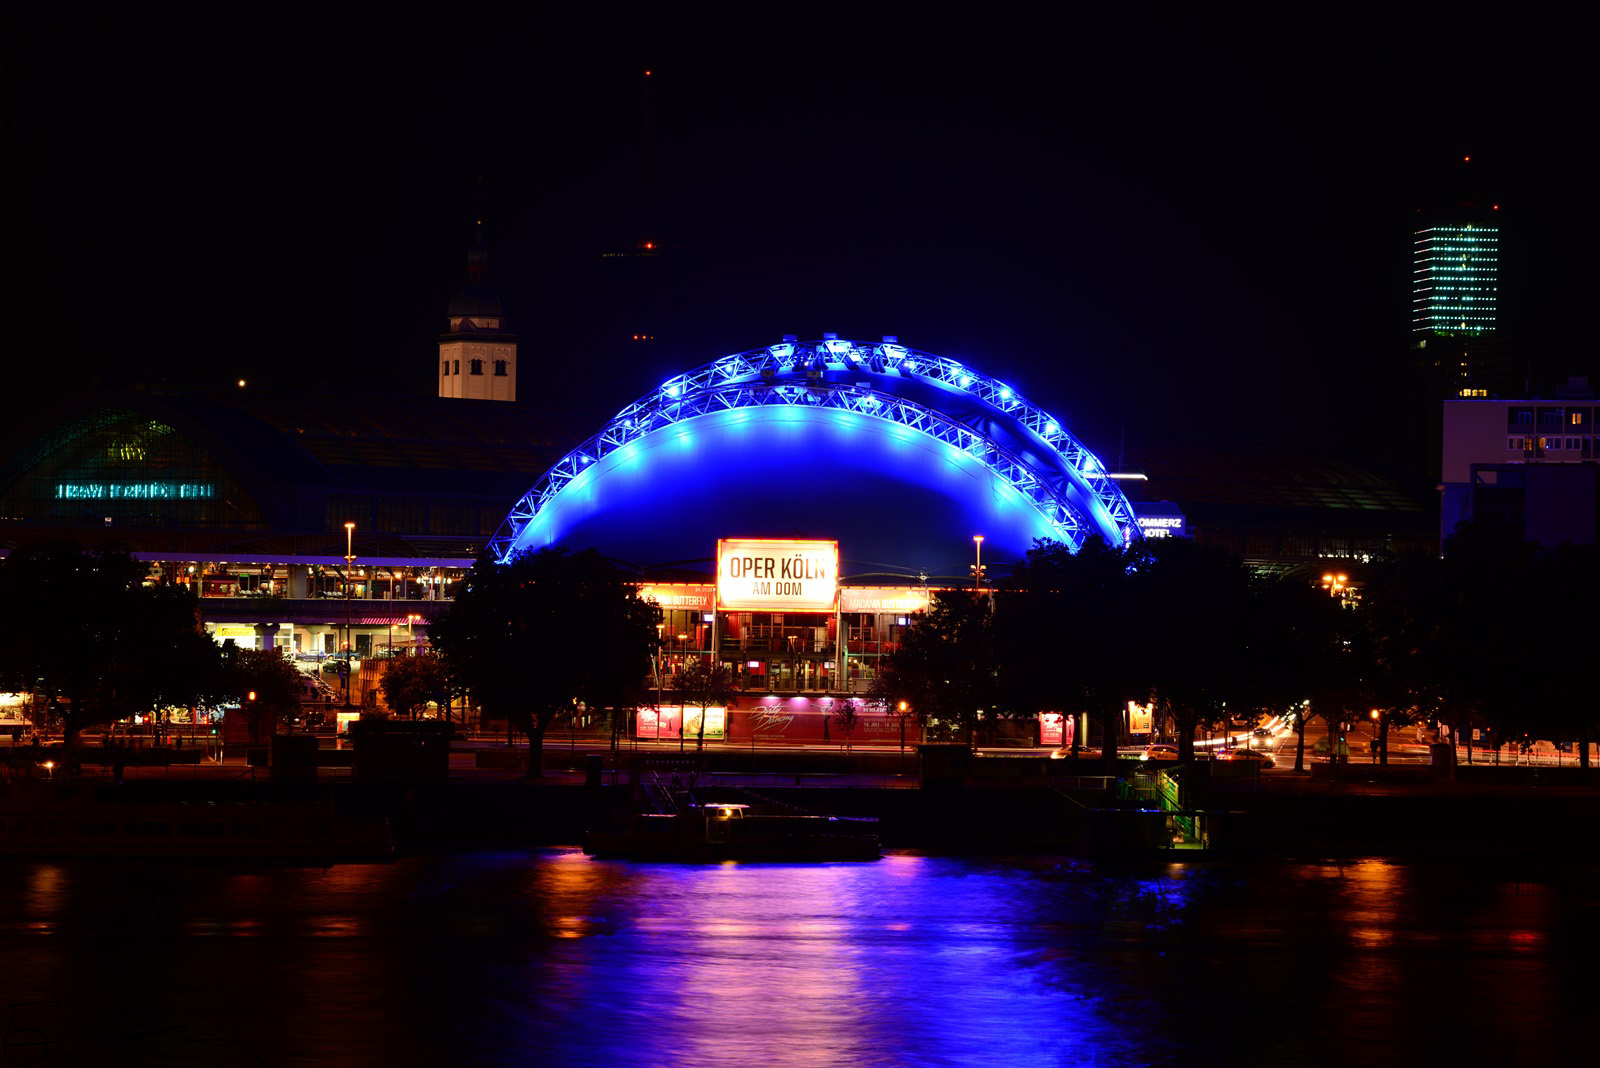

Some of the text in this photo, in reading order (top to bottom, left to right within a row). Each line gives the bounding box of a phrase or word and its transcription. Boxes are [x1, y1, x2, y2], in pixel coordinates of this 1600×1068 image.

[1138, 518, 1181, 527] OMMERZ
[730, 553, 825, 579] OPER KÖLN
[752, 582, 802, 596] AM DOM
[673, 596, 707, 606] BUTTERFLY
[747, 704, 788, 720] Dirty
[752, 714, 795, 732] Dancing
